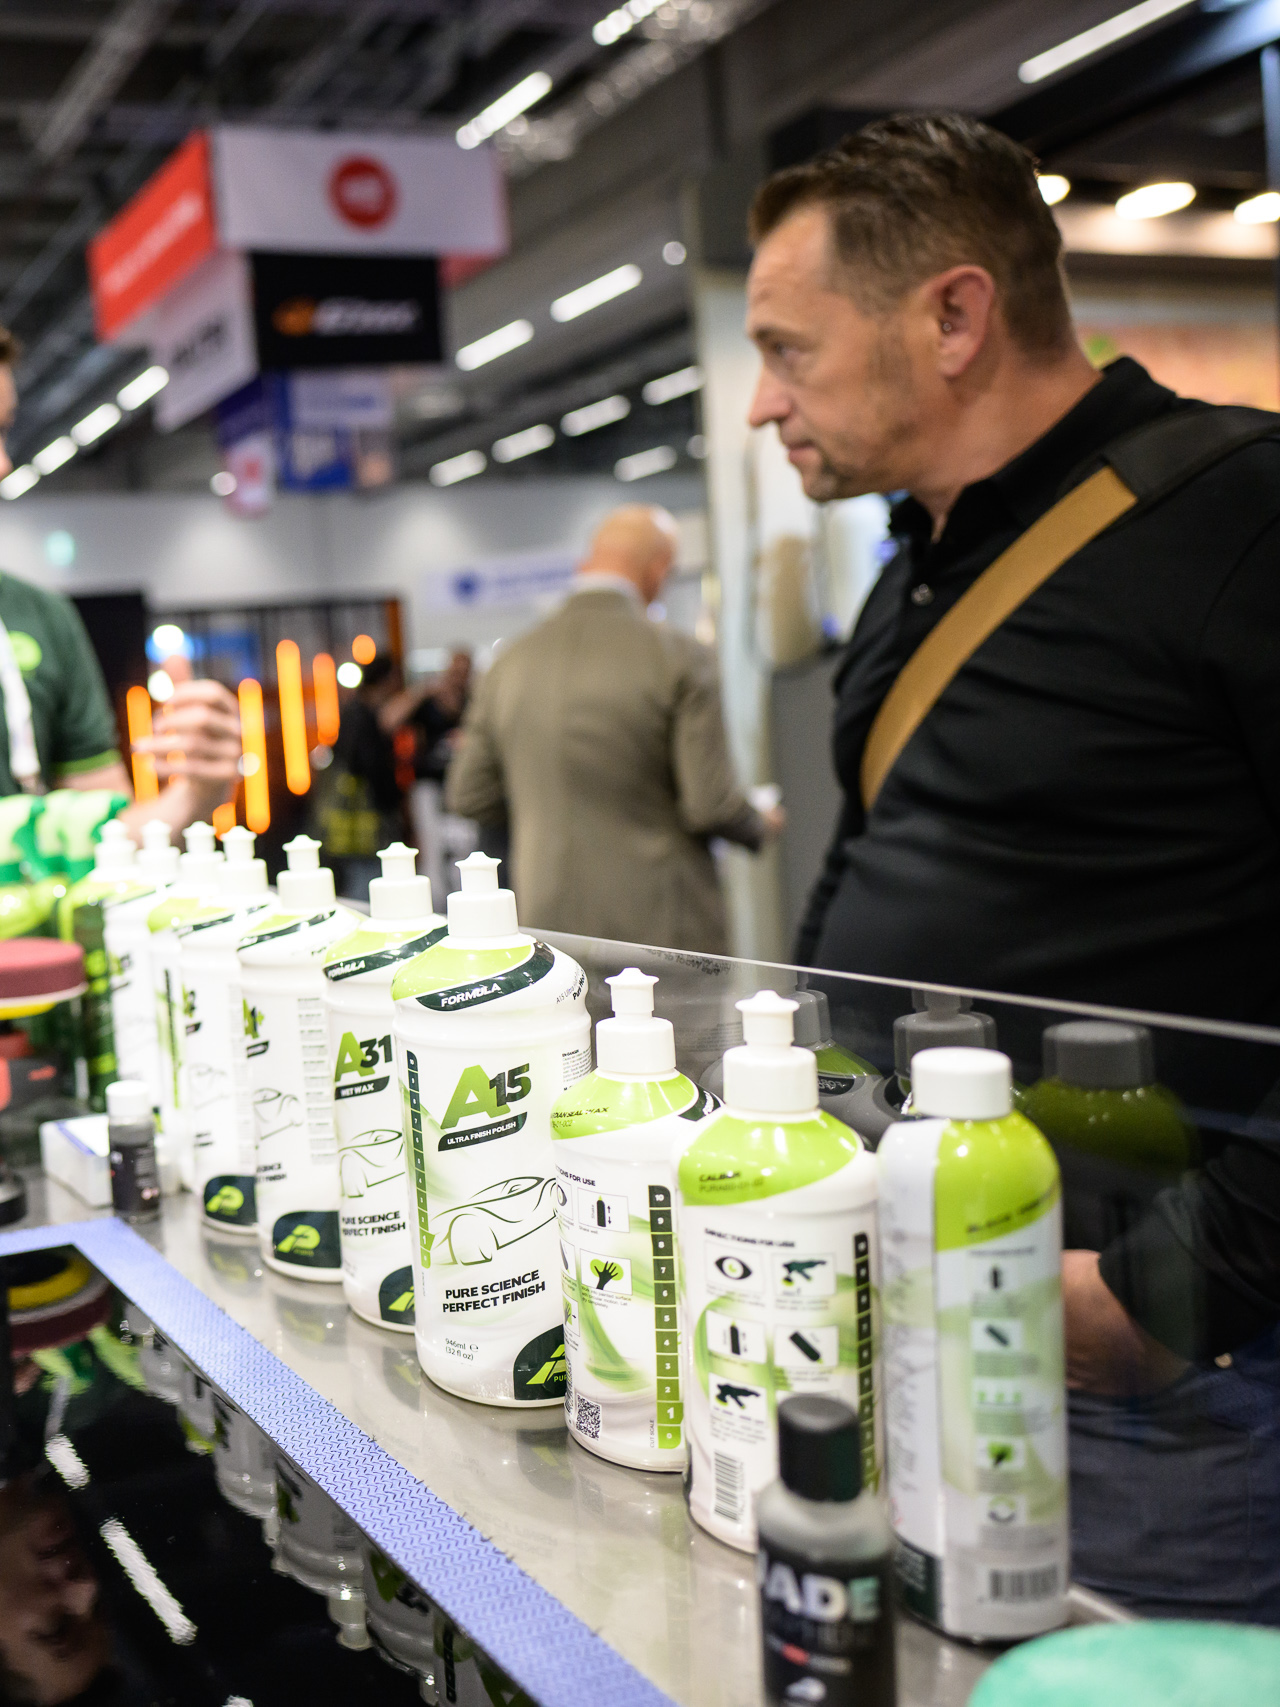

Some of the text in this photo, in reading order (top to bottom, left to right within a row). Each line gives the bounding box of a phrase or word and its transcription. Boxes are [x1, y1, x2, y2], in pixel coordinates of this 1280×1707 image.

[441, 982, 502, 1007] FORMULA
[334, 1031, 393, 1083] A31
[355, 1082, 375, 1096] WAX
[440, 1062, 532, 1130] A15
[447, 1121, 517, 1145] ULTRA FINISH POLISH
[569, 1173, 581, 1183] FOR
[582, 1178, 596, 1187] USE
[655, 1194, 664, 1202] 10
[358, 1210, 400, 1225] SCIENCE
[657, 1217, 664, 1225] 9
[371, 1221, 405, 1235] FINISH
[658, 1241, 665, 1249] 8
[660, 1266, 667, 1274] 7
[445, 1286, 479, 1299] PURE
[481, 1269, 540, 1295] SCIENCE
[442, 1296, 500, 1313] PERFECT
[502, 1281, 546, 1304] FINISH
[662, 1289, 668, 1297] 6
[663, 1314, 670, 1322] 5
[445, 1338, 466, 1350] 946ml
[445, 1347, 456, 1356] (32
[462, 1353, 474, 1361] oz)
[665, 1362, 671, 1370] 3
[667, 1407, 674, 1419] 1
